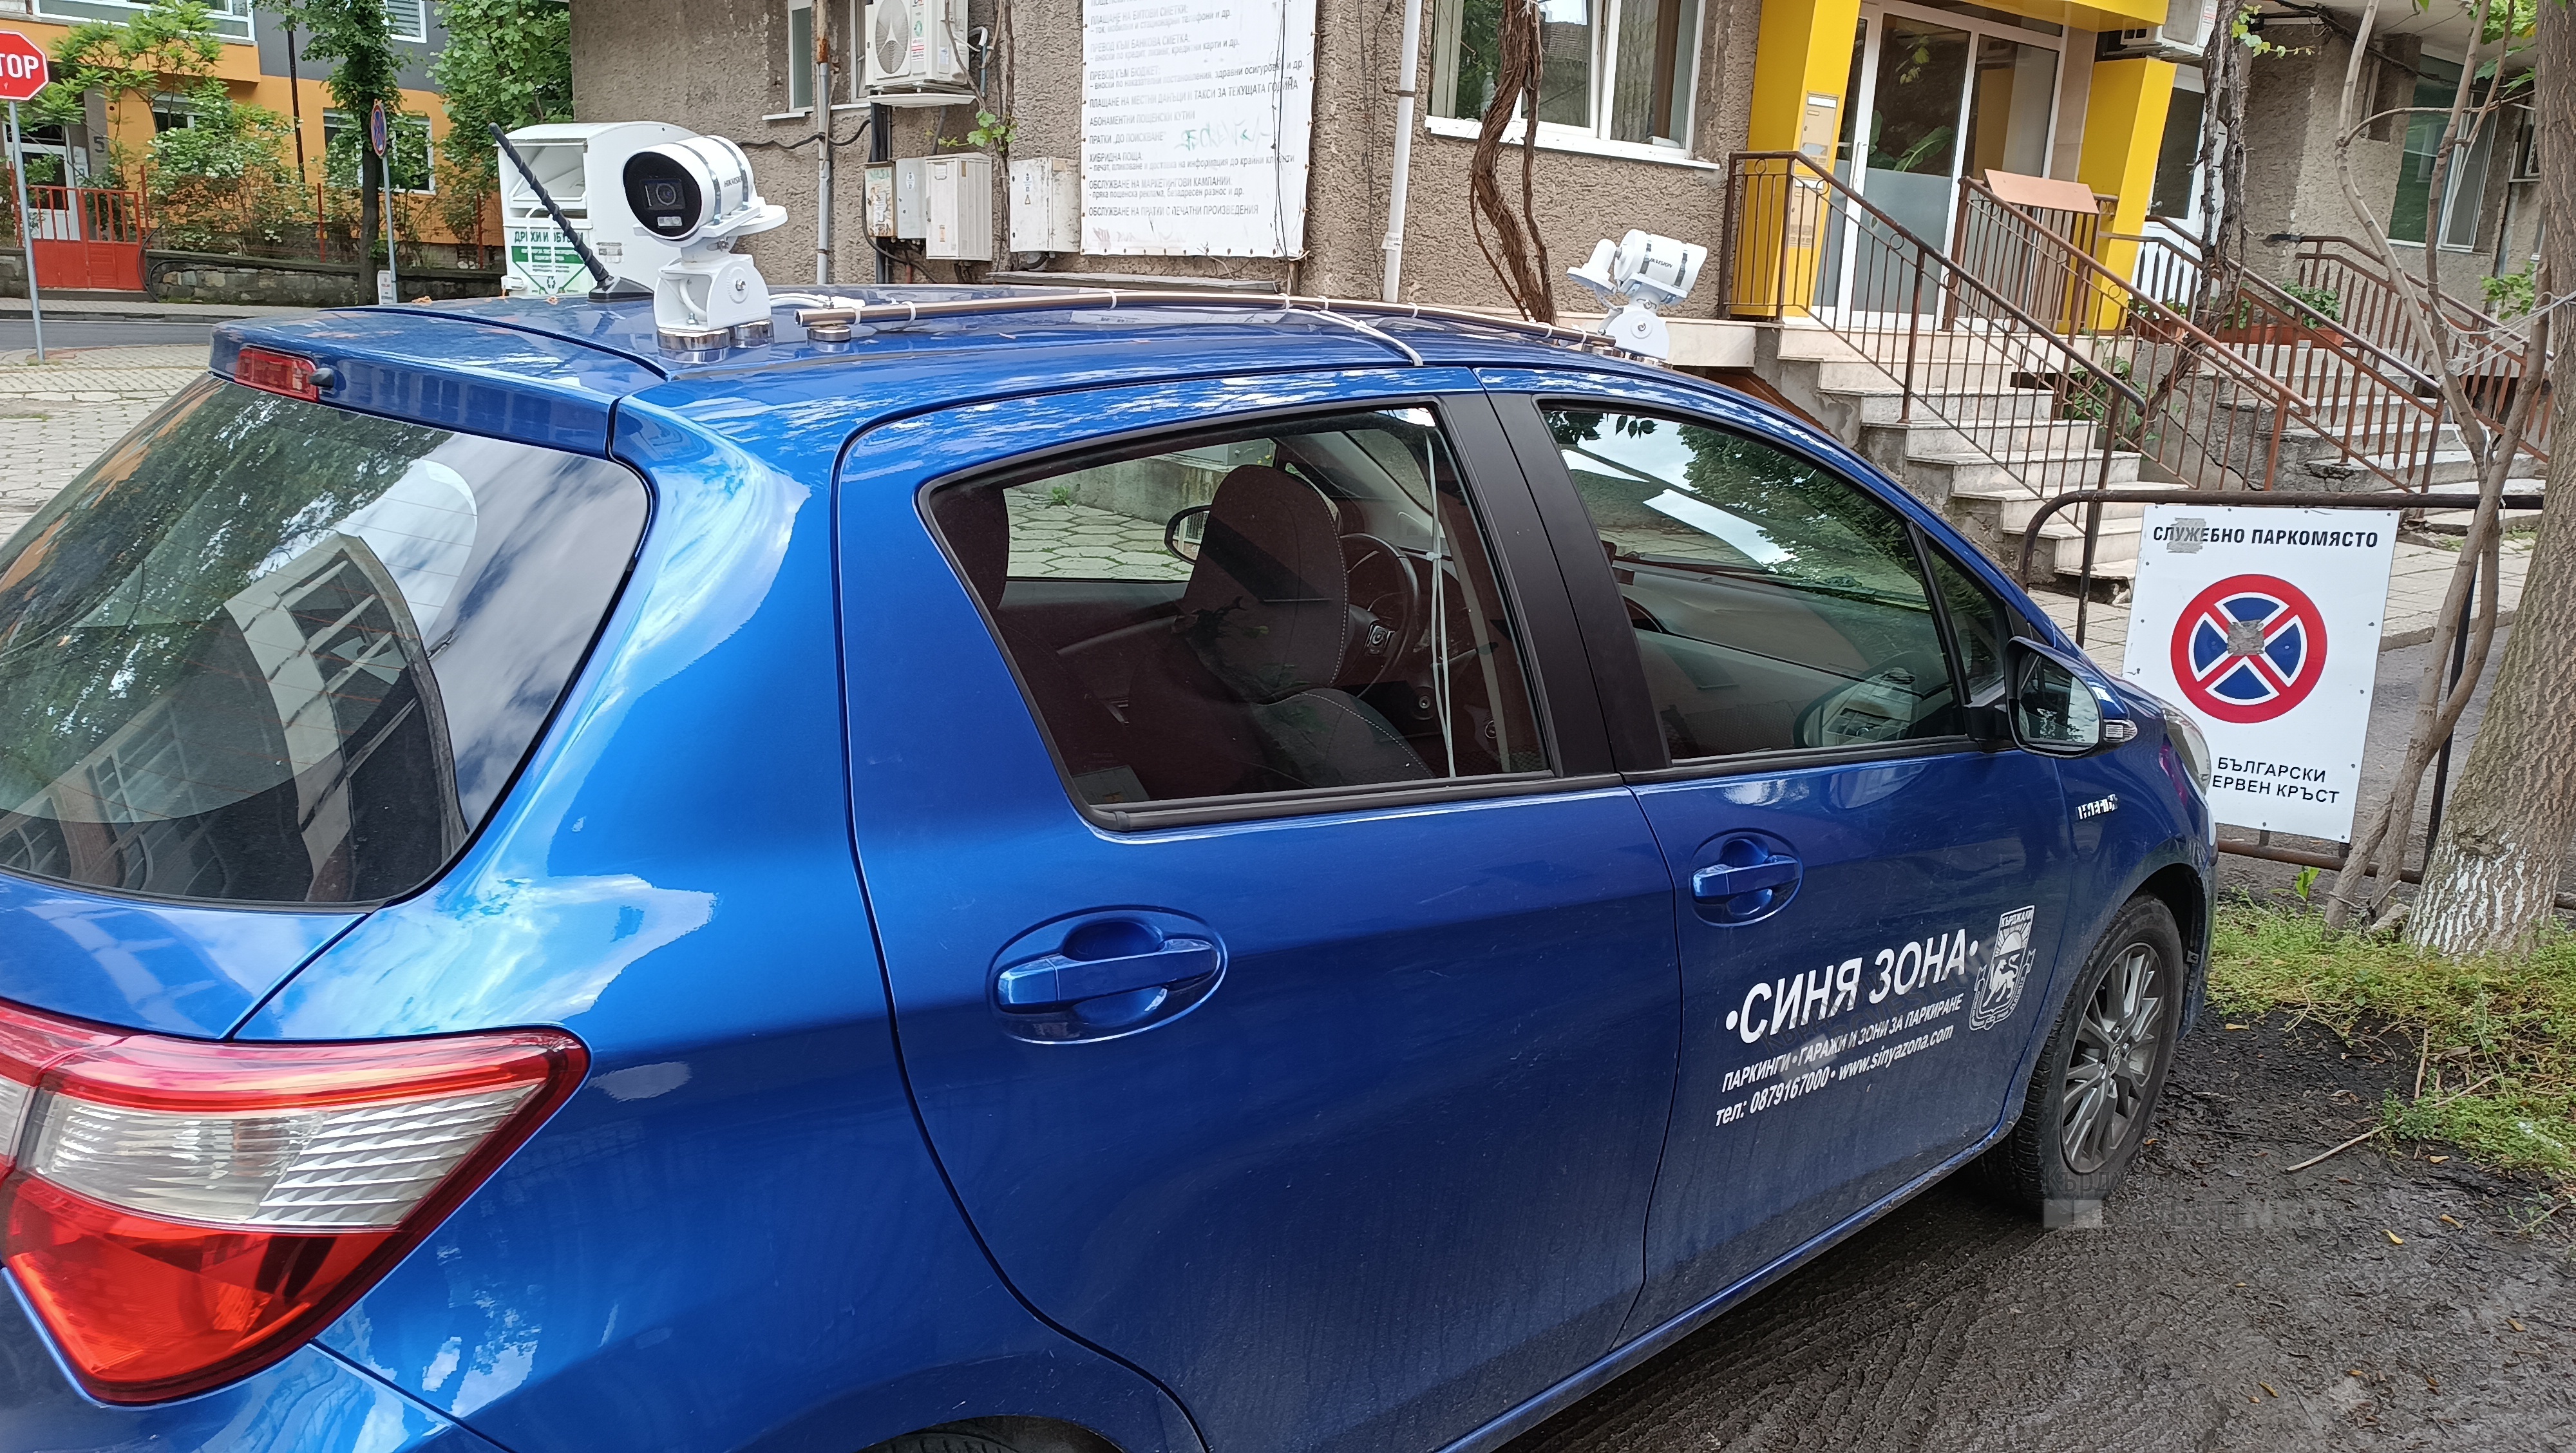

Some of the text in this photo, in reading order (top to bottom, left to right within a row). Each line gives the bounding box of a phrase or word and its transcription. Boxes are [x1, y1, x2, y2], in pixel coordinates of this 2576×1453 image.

[1090, 13, 1121, 25] ПЛАЩАНЕ
[1122, 12, 1131, 21] НА
[1133, 8, 1159, 20] БИТОВИ
[1090, 41, 1115, 53] ПРЕВОД
[1116, 40, 1130, 50] КЪМ
[1131, 37, 1160, 48] БАНКОВА
[1203, 41, 1221, 52] карти
[0, 53, 39, 79] TOP
[1215, 68, 1243, 80] здравни
[1244, 64, 1282, 76] осигуровк
[1090, 69, 1114, 81] ПРЕВОД
[1115, 68, 1129, 78] КЪМ
[1090, 97, 1119, 108] ПЛАЩАНЕ
[1121, 96, 1130, 106] НА
[1131, 94, 1157, 105] МЕСТНИ
[1158, 91, 1186, 105] ДАНЪЦИ
[1195, 89, 1215, 100] ТАКСИ
[1217, 88, 1226, 98] ЗА
[1228, 84, 1265, 97] ТЕКУЩАТА
[1090, 111, 1195, 126] АБОНАМЕНТНИ ПОЩЕНСКИ КУТИИ
[93, 136, 106, 153] 5
[1090, 135, 1112, 144] ПРАТКИ
[1090, 153, 1121, 162] ХИБРИДНА
[1187, 158, 1228, 169] информация
[1230, 158, 1238, 167] до
[1240, 155, 1264, 167] крайни
[1089, 180, 1130, 189] ОБСЛУЖВАНЕ
[1132, 180, 1139, 189] НА
[1167, 187, 1202, 198] безадресен
[1204, 189, 1226, 198] разнос
[1089, 207, 1130, 216] ОБСЛУЖВАНЕ
[1131, 207, 1139, 216] НА
[1141, 206, 1164, 216] ПРАТКИ
[1171, 205, 1202, 216] ПЕЧАТНИ
[1203, 205, 1258, 216] ПРОИЗВЕДЕНИЯ
[515, 231, 541, 243] ДРХИ
[2153, 526, 2378, 547] СЛУЖЕБНО ПАРКОМЯСТО
[2217, 757, 2326, 783] БЪЛГАРСКИ
[2212, 775, 2340, 804] ЕРВЕН КРЪСТ
[1740, 957, 1863, 1043] СИНЯ
[1869, 929, 1965, 1004] ЗОНА
[1721, 1052, 1792, 1093] ПАРКИНГИ
[1848, 1030, 1859, 1049] И
[1857, 1019, 1889, 1045] ЗОНИ
[1889, 1014, 1904, 1034] ЗА
[1904, 992, 1964, 1029] ПАРКИРАНЕ
[1715, 1025, 1955, 1127] тел: 0879167000 www.sinyazona.com
